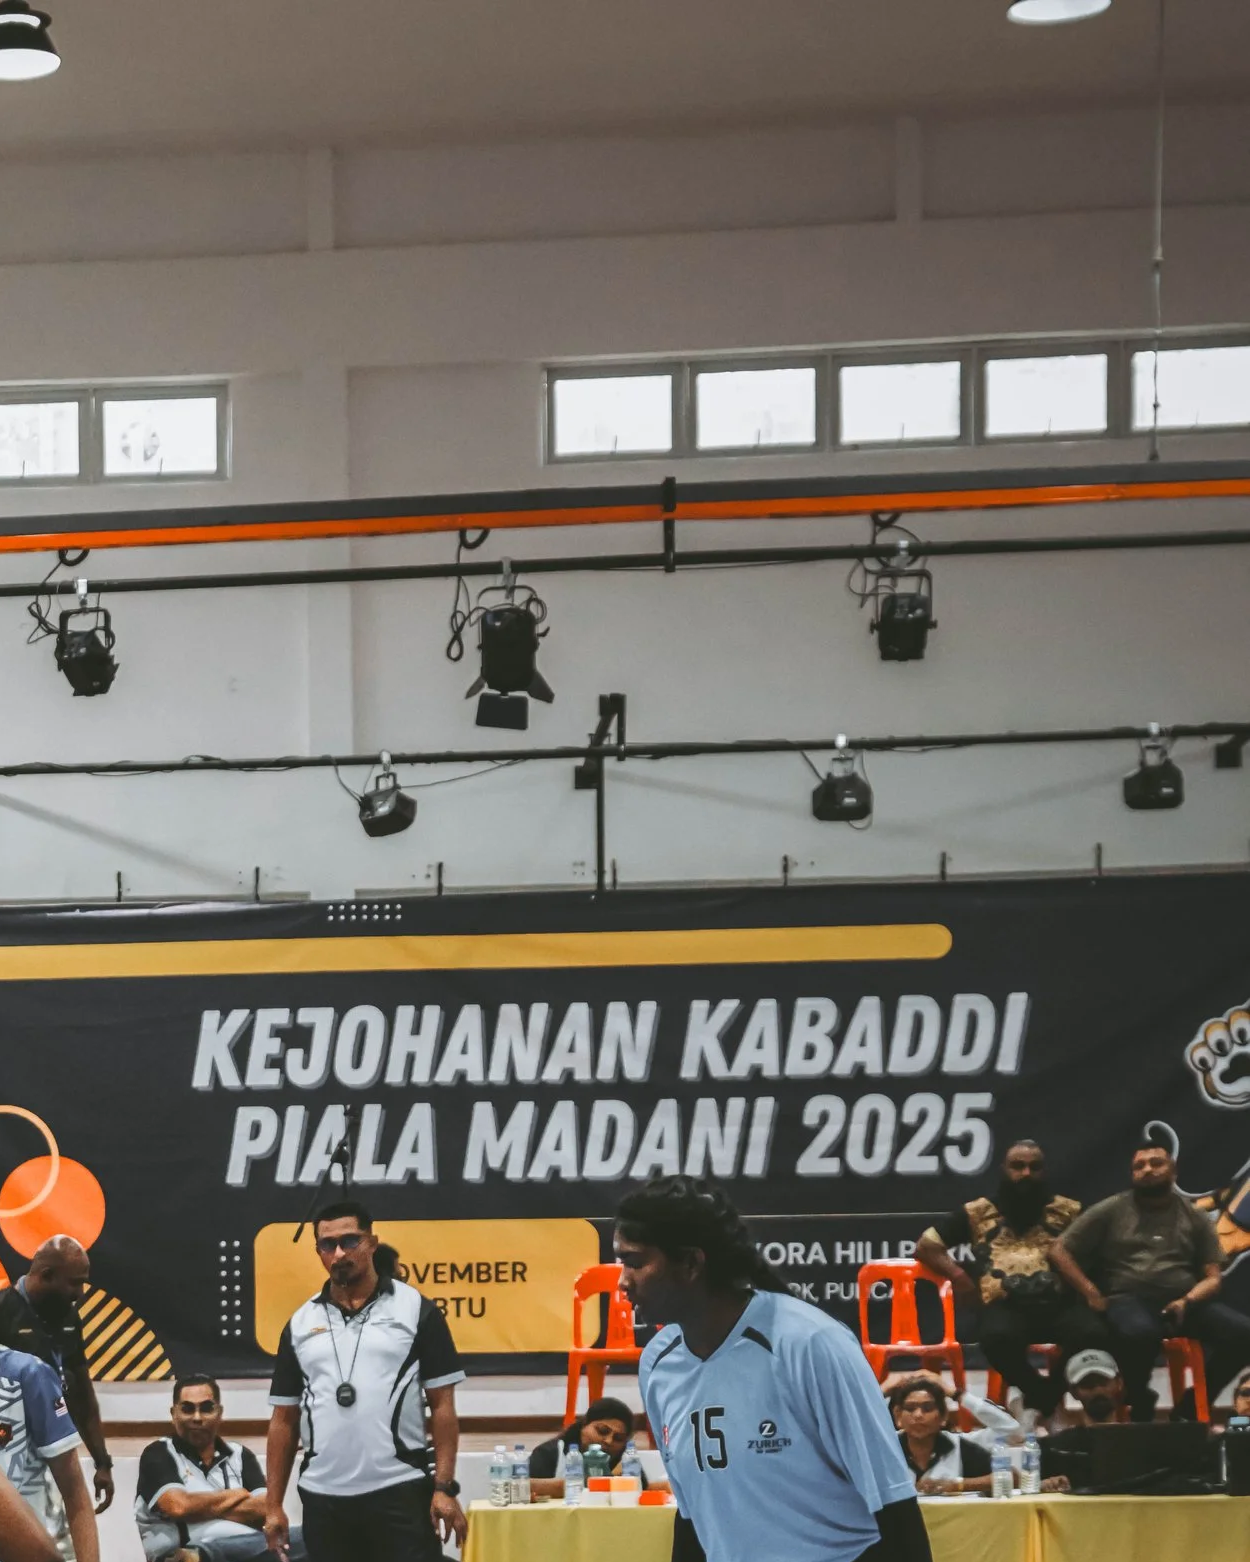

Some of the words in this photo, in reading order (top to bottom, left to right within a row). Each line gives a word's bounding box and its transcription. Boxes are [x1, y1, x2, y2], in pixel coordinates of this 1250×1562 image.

[192, 1001, 658, 1090] KEJOHANAN
[680, 992, 1029, 1080] KABADDI
[226, 1102, 437, 1186] PIALA
[463, 1096, 776, 1183] MADANI
[796, 1092, 995, 1178] 2025
[399, 1261, 528, 1284] OVEMBER
[690, 1406, 729, 1473] 15
[746, 1437, 792, 1449] ZURICH
